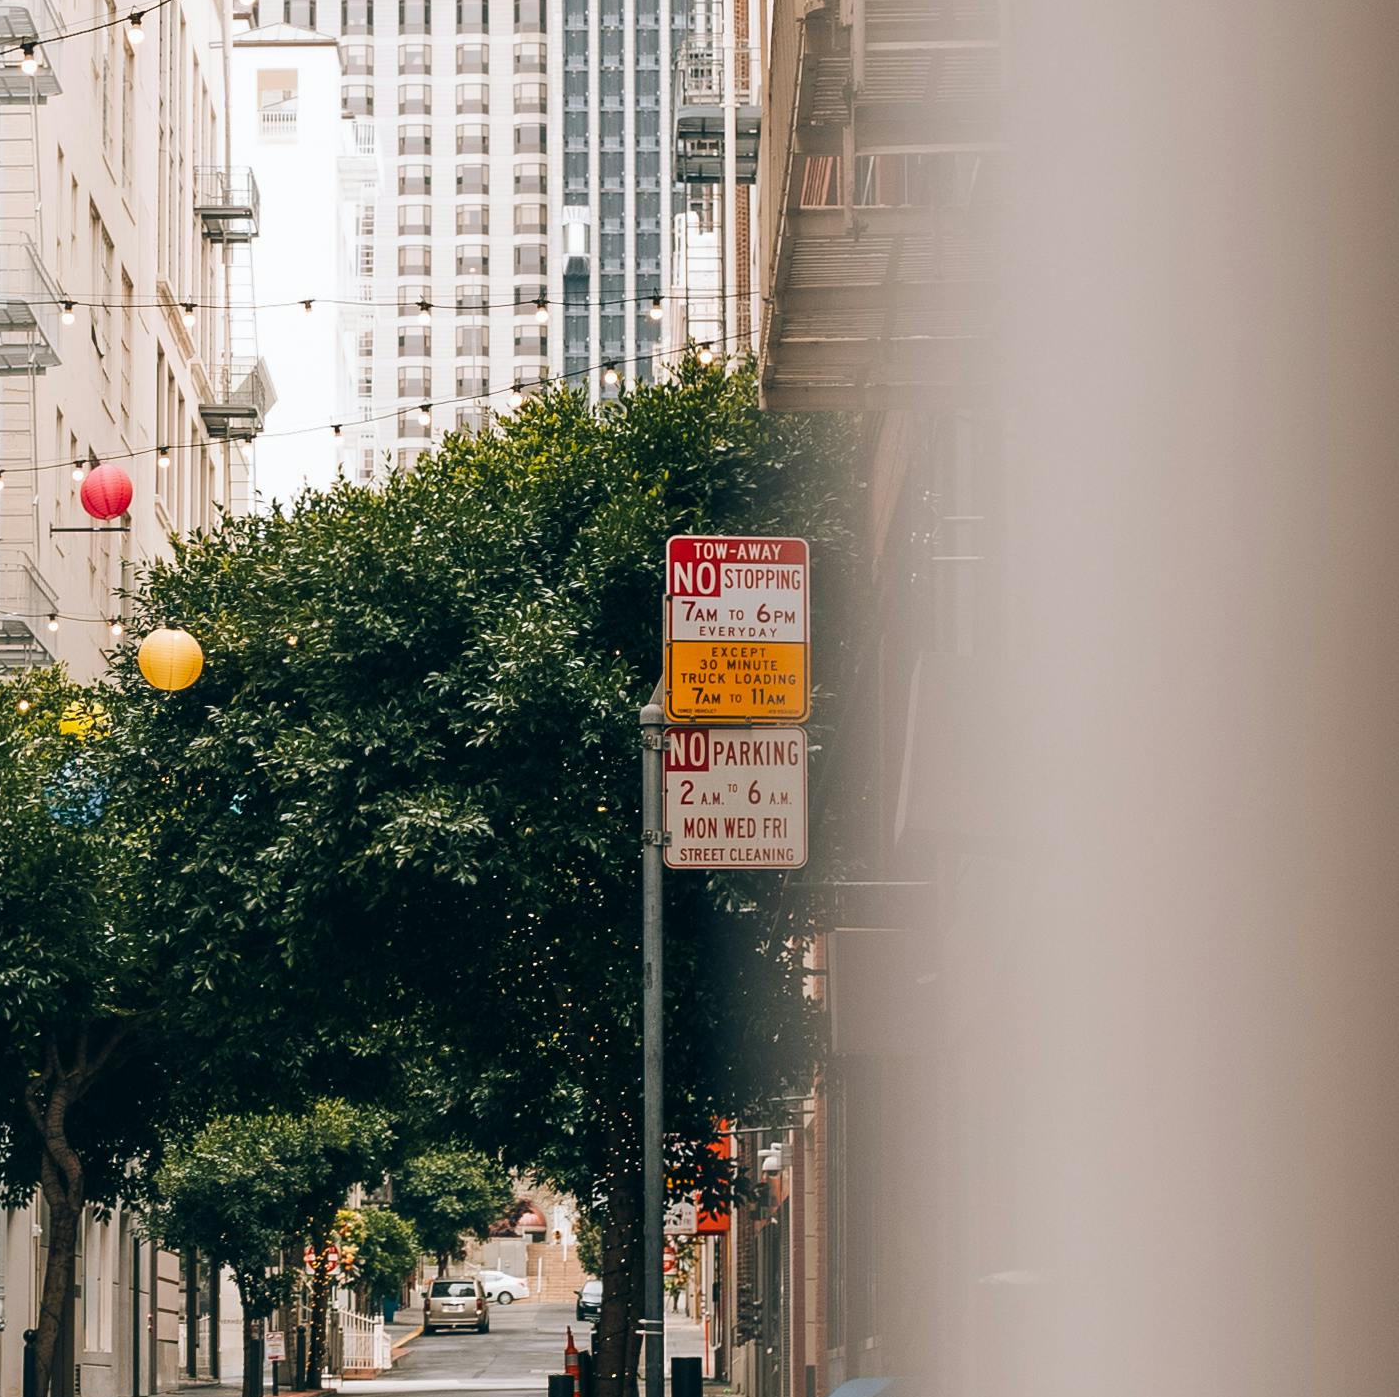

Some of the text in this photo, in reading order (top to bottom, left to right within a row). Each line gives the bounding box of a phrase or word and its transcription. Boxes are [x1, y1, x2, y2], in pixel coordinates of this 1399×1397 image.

[693, 542, 782, 561] TOW-AWAY
[673, 561, 801, 595] NO STOPPING
[681, 600, 796, 624] 7AM TO 6PM
[699, 626, 777, 637] EVERYDAY
[711, 647, 767, 658] EXCEPT
[699, 659, 778, 671] 30 MINUTE
[681, 672, 796, 685] TRUCK LOADING
[691, 687, 785, 705] 7AM TO 11AM
[670, 731, 799, 767] NO PARKING
[680, 779, 792, 805] 2 A.M. TO 6 A.M.
[684, 817, 787, 839] MON WED FRI
[680, 847, 794, 862] STREET CLEANING
